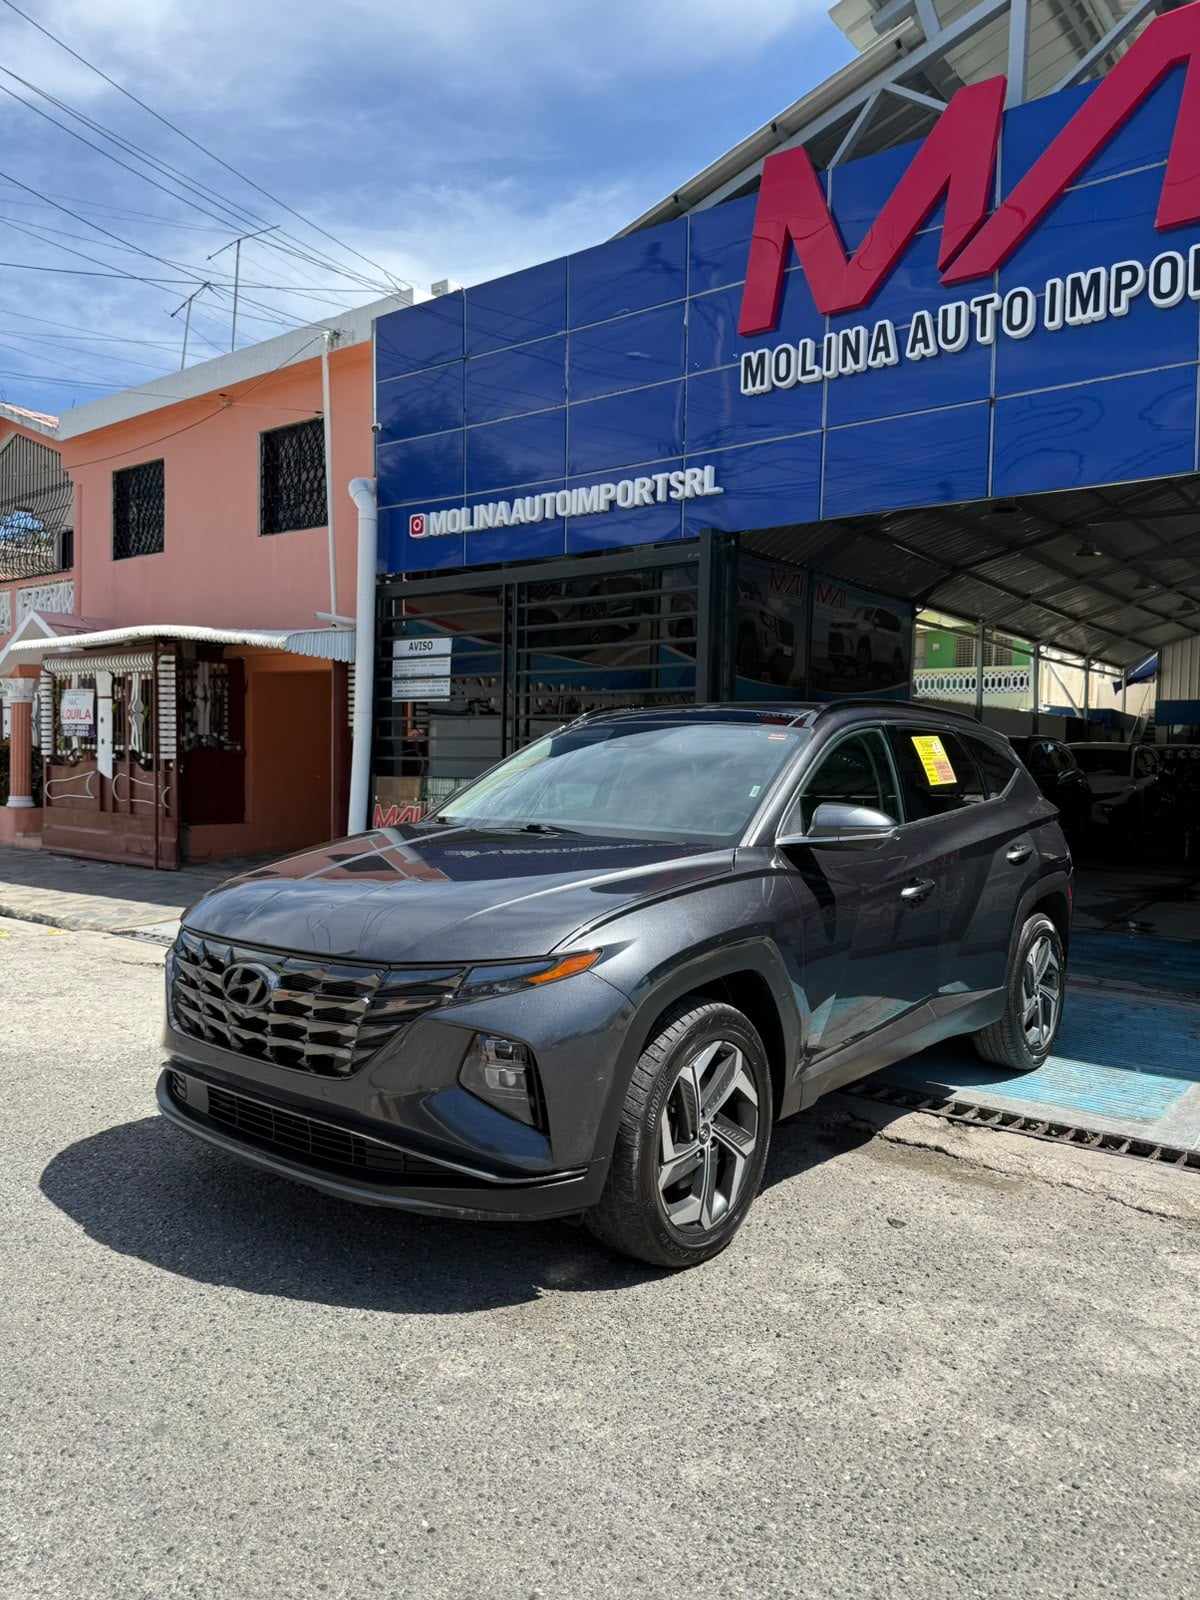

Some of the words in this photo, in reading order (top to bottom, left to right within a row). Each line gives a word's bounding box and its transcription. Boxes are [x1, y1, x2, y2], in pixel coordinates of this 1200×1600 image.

[740, 319, 898, 396] MOLINA
[906, 287, 1037, 359] AUTO
[1044, 243, 1200, 331] IMPO
[429, 465, 724, 536] MOLINAAUTOIMPORTSRL
[409, 640, 433, 651] AVISO
